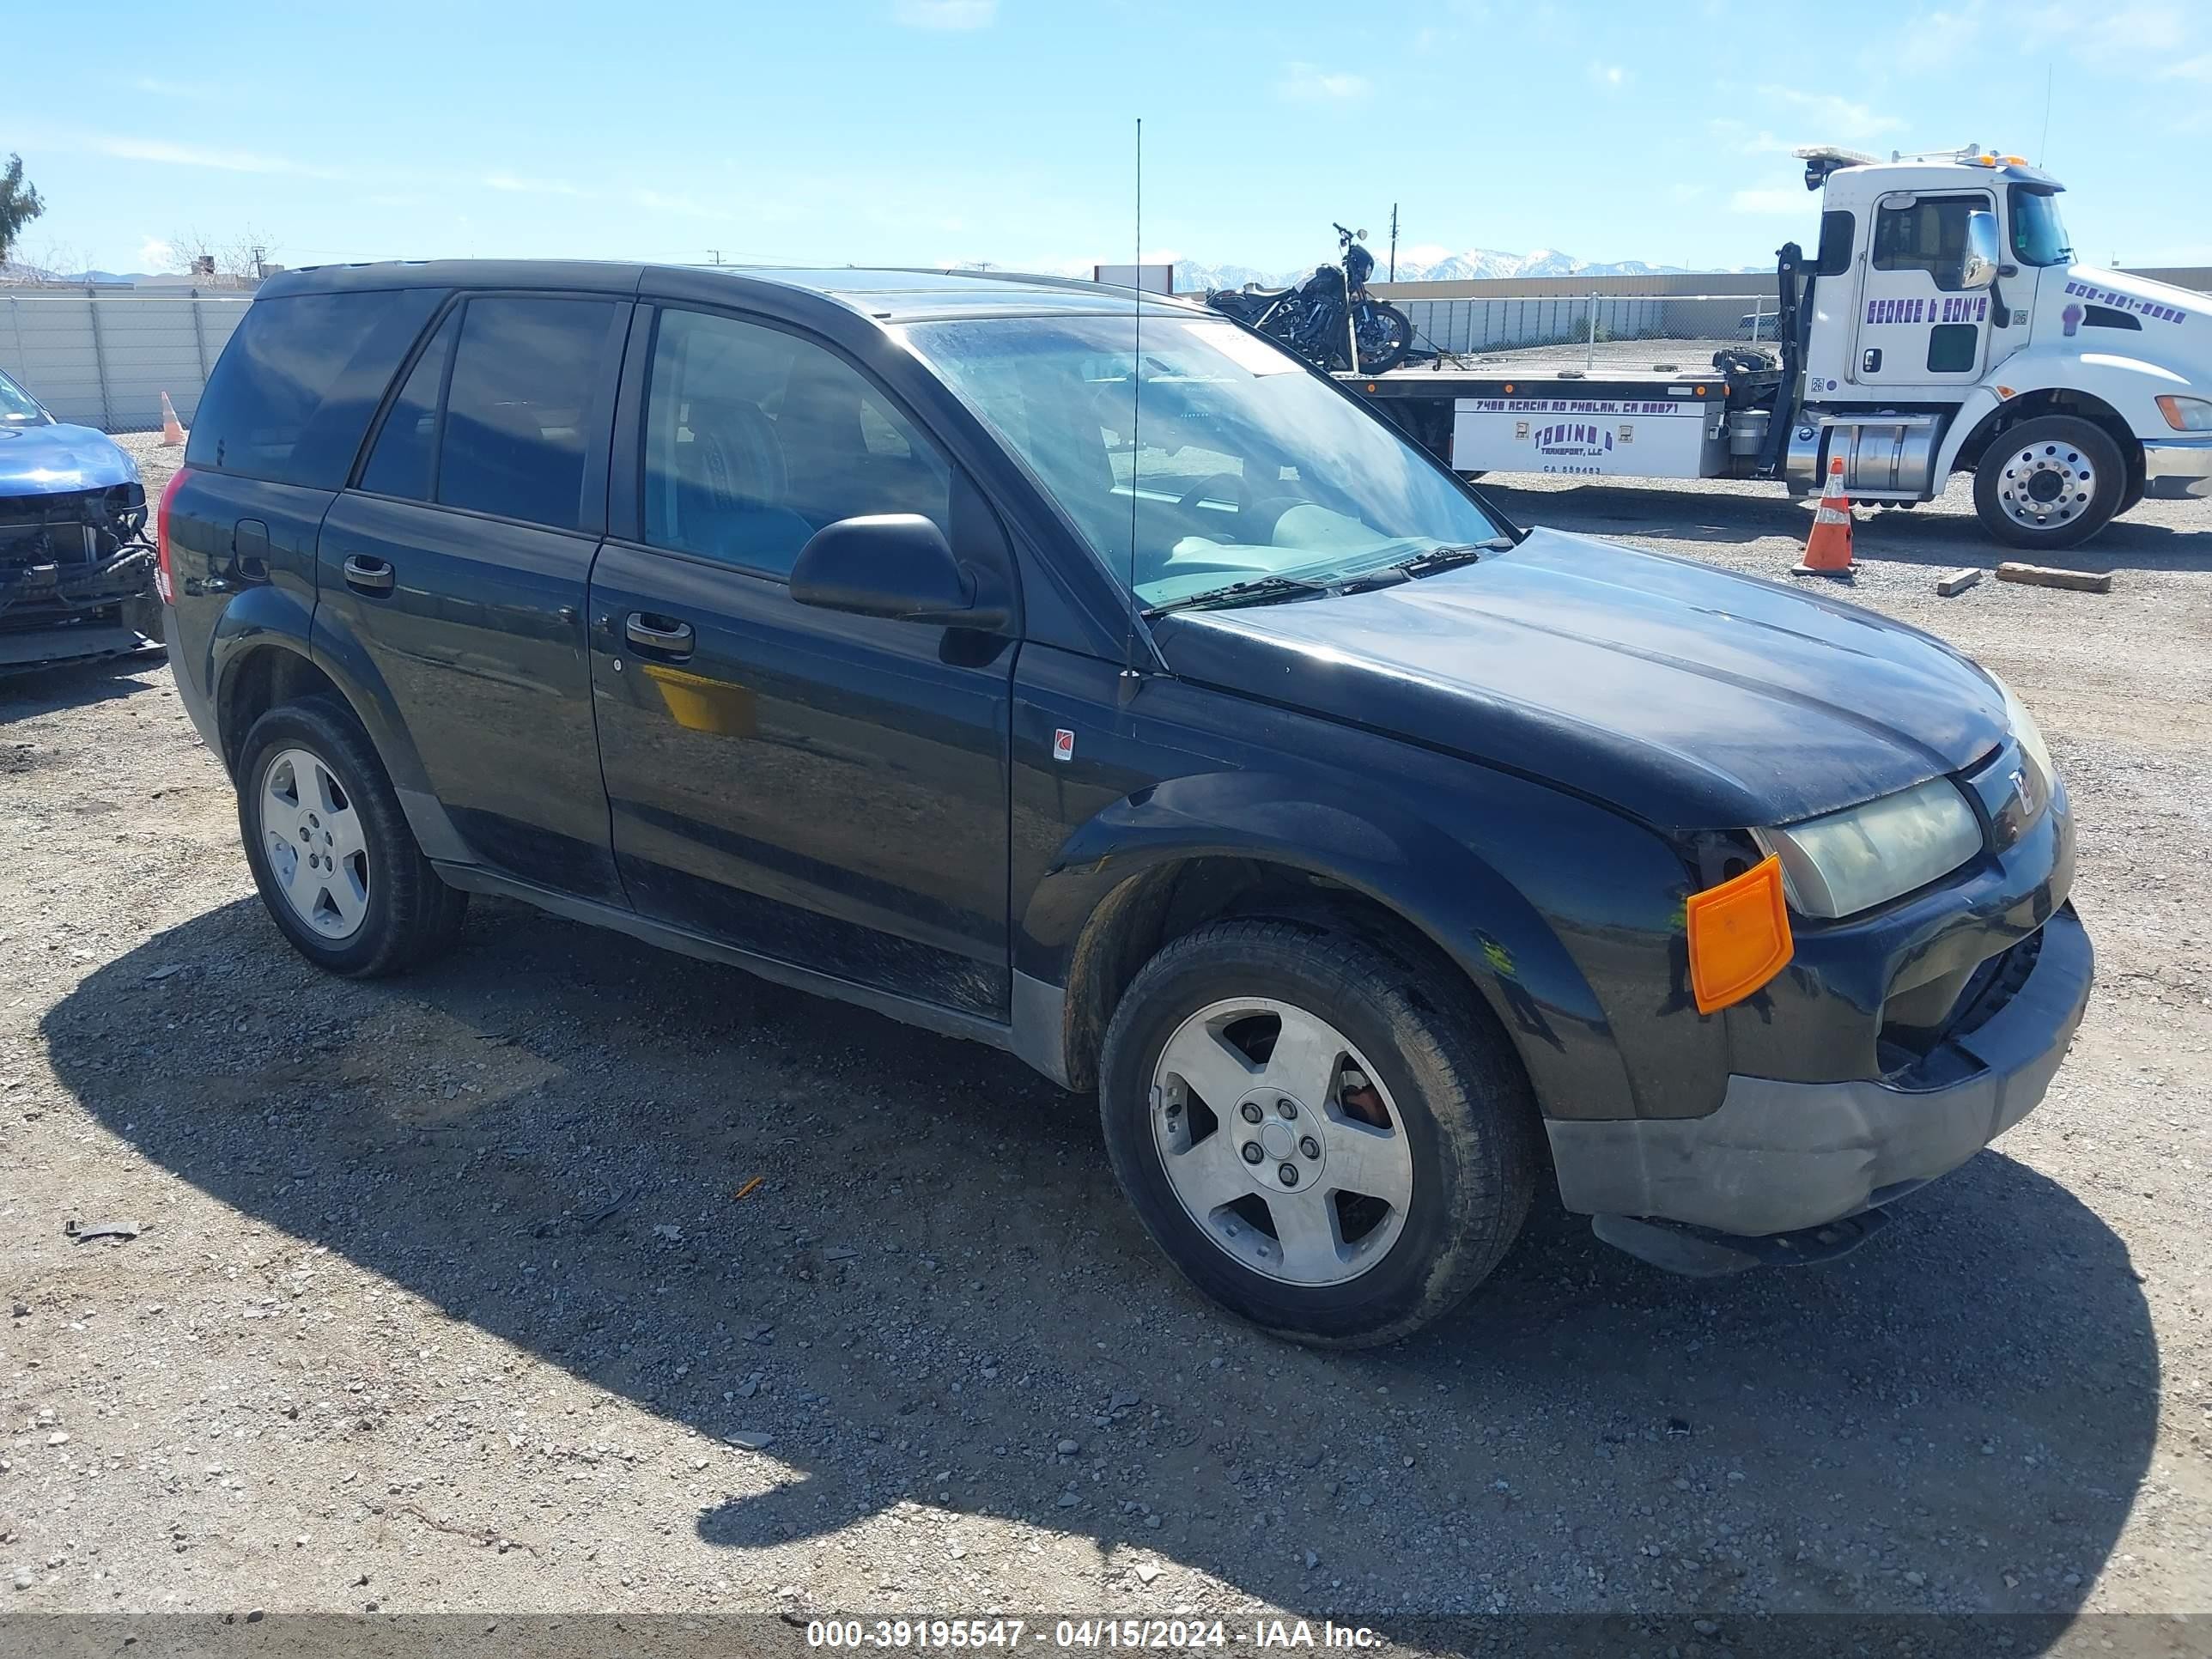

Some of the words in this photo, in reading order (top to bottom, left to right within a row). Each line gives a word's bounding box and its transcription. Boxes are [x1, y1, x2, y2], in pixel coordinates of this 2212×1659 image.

[1866, 298, 1923, 325] GEORGE
[1942, 296, 1987, 323] SON'S
[1813, 381, 1823, 391] 26
[1509, 400, 1549, 411] ACACIA
[1622, 403, 1638, 413] CA
